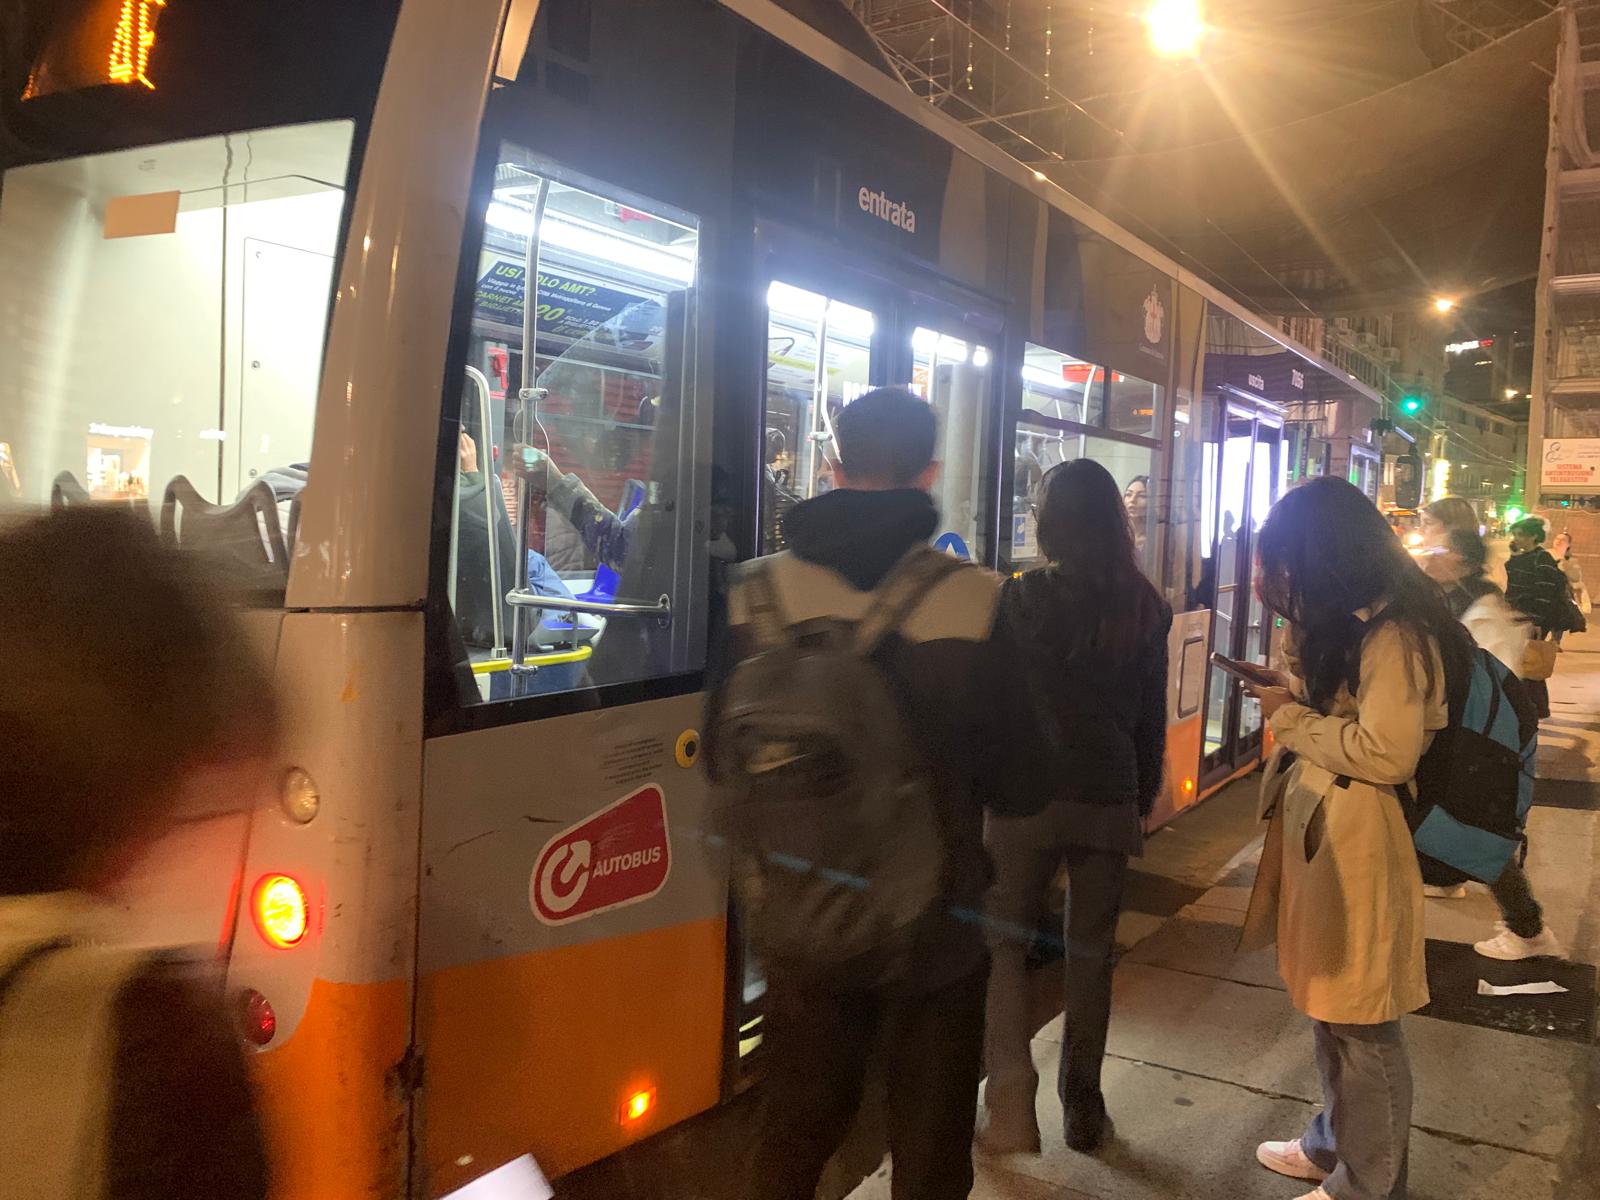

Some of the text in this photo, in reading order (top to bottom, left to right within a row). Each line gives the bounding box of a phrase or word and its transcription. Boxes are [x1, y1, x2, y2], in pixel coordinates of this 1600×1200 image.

[858, 187, 915, 233] entrata
[496, 265, 523, 279] USI
[559, 281, 596, 296] AMT?
[592, 846, 662, 879] AUTOBUS
